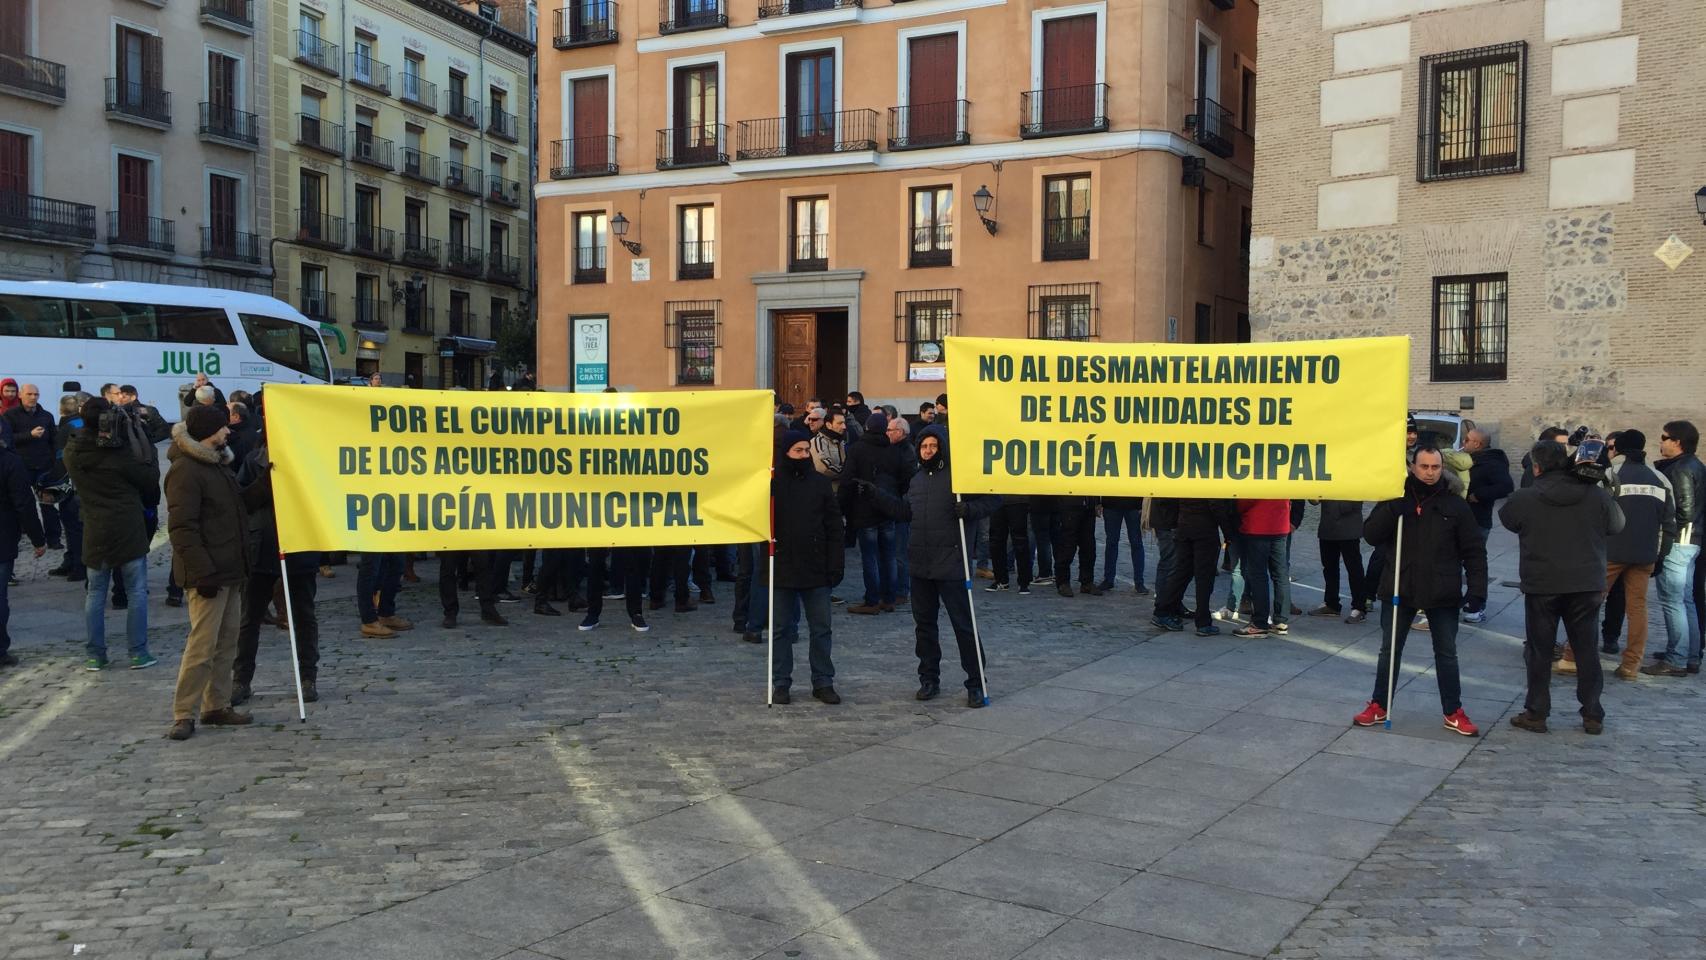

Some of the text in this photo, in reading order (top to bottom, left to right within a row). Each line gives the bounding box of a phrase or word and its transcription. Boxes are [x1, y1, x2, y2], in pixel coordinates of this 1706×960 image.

[979, 354, 1340, 385] NO AL DESMANTELAMIENTO
[369, 404, 680, 436] POR EL CUMPLIMIENTO
[1020, 395, 1293, 426] DE LAS UNIDADES DE
[339, 445, 709, 476] DE LOS ACUERDOS FIRMADOS
[982, 433, 1332, 481] POLICÍA MUNICIPAL
[346, 486, 704, 533] POLICÍA MUNICIPAL
